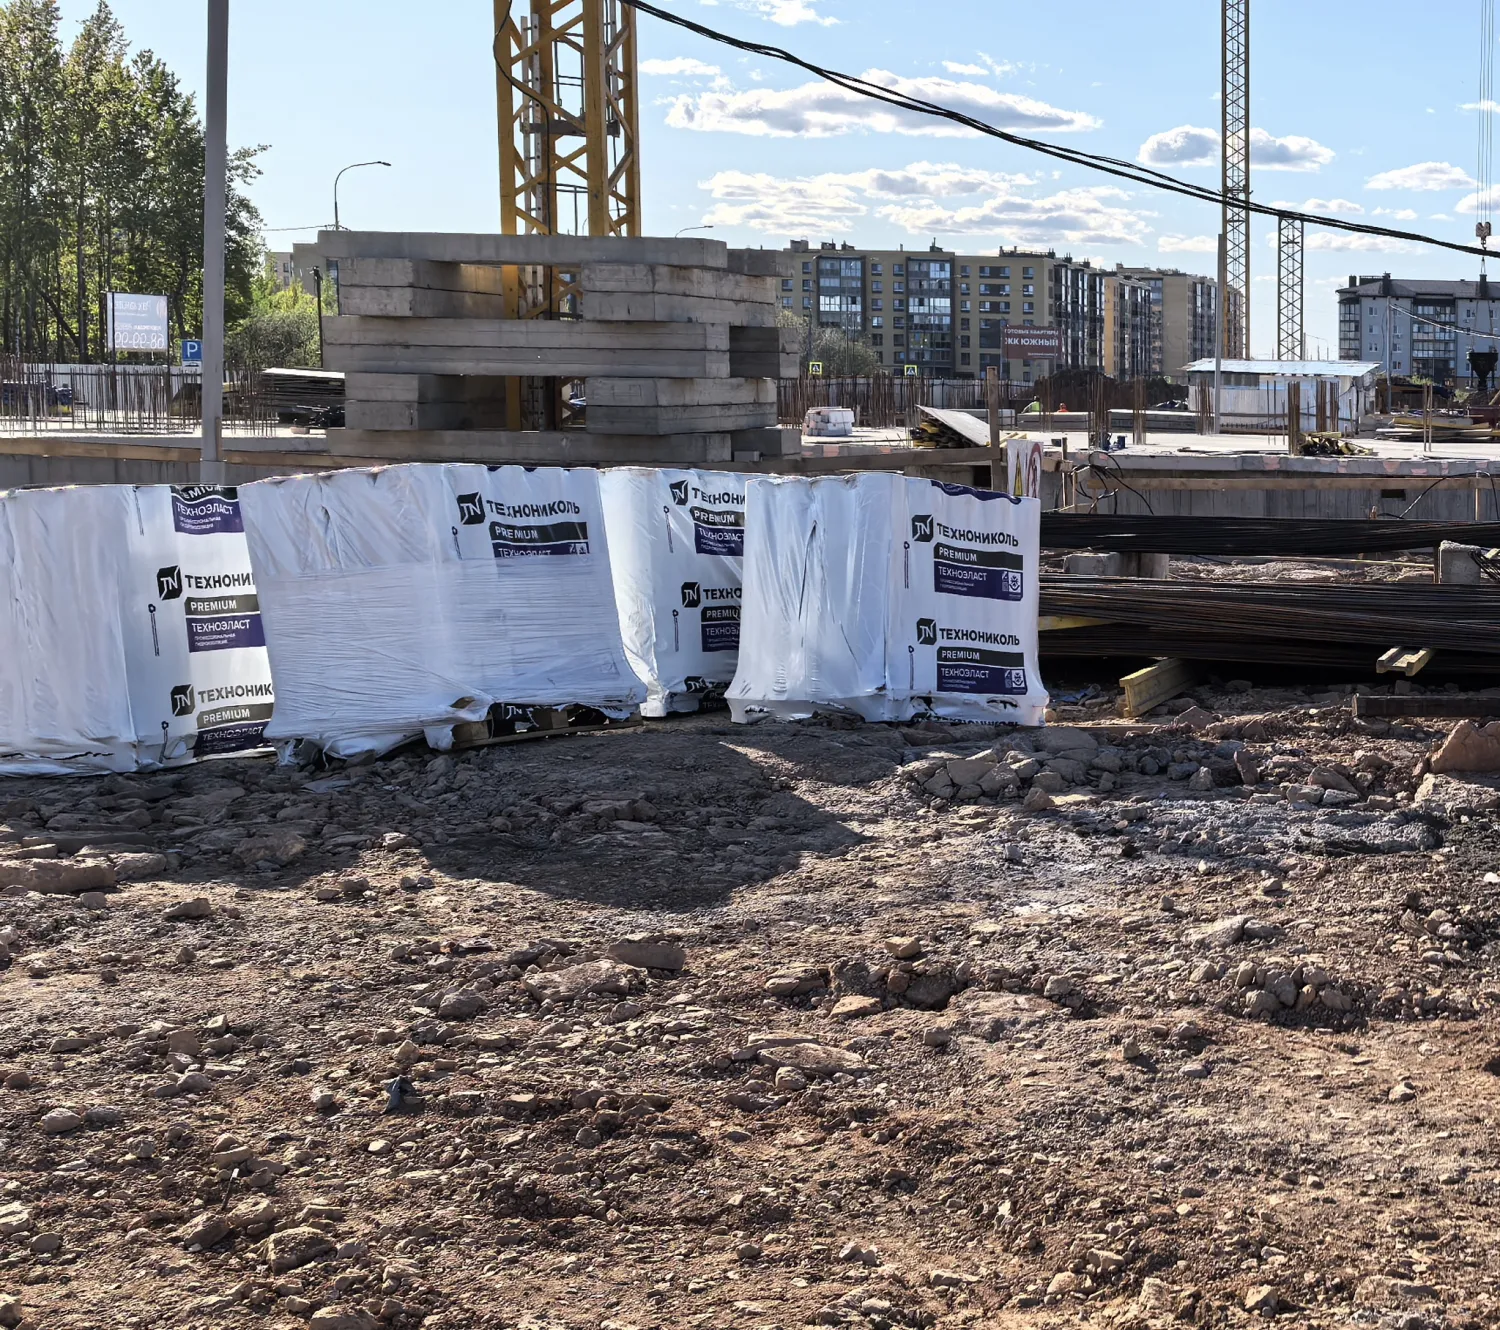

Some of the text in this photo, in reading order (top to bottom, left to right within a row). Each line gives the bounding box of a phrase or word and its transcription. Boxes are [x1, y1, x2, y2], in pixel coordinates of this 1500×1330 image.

[186, 341, 198, 358] P
[1020, 337, 1059, 346] ЮЖНЫЙ
[175, 502, 234, 517] ТЕХНОЭЛАСТ
[486, 500, 581, 518] ТЕХНОНИКОЛЬ
[937, 522, 1019, 548] ТЕХНОНИКОЛЬ
[938, 546, 978, 562] PREMIUM
[184, 572, 255, 589] ТЕХНОНИ
[938, 565, 988, 581] ТЕХНОЭЛАСТ
[190, 599, 237, 612] PREMIUM
[191, 619, 251, 633] ТЕХНОЭЛАСТ
[938, 627, 1020, 646] ТЕХНОНИКОЛЬ
[941, 649, 980, 661] PREMIUM
[940, 667, 990, 679] ТЕХНОЭЛАСТ
[197, 683, 273, 703] ТЕХНОНИК
[202, 708, 251, 724] PREMIUM
